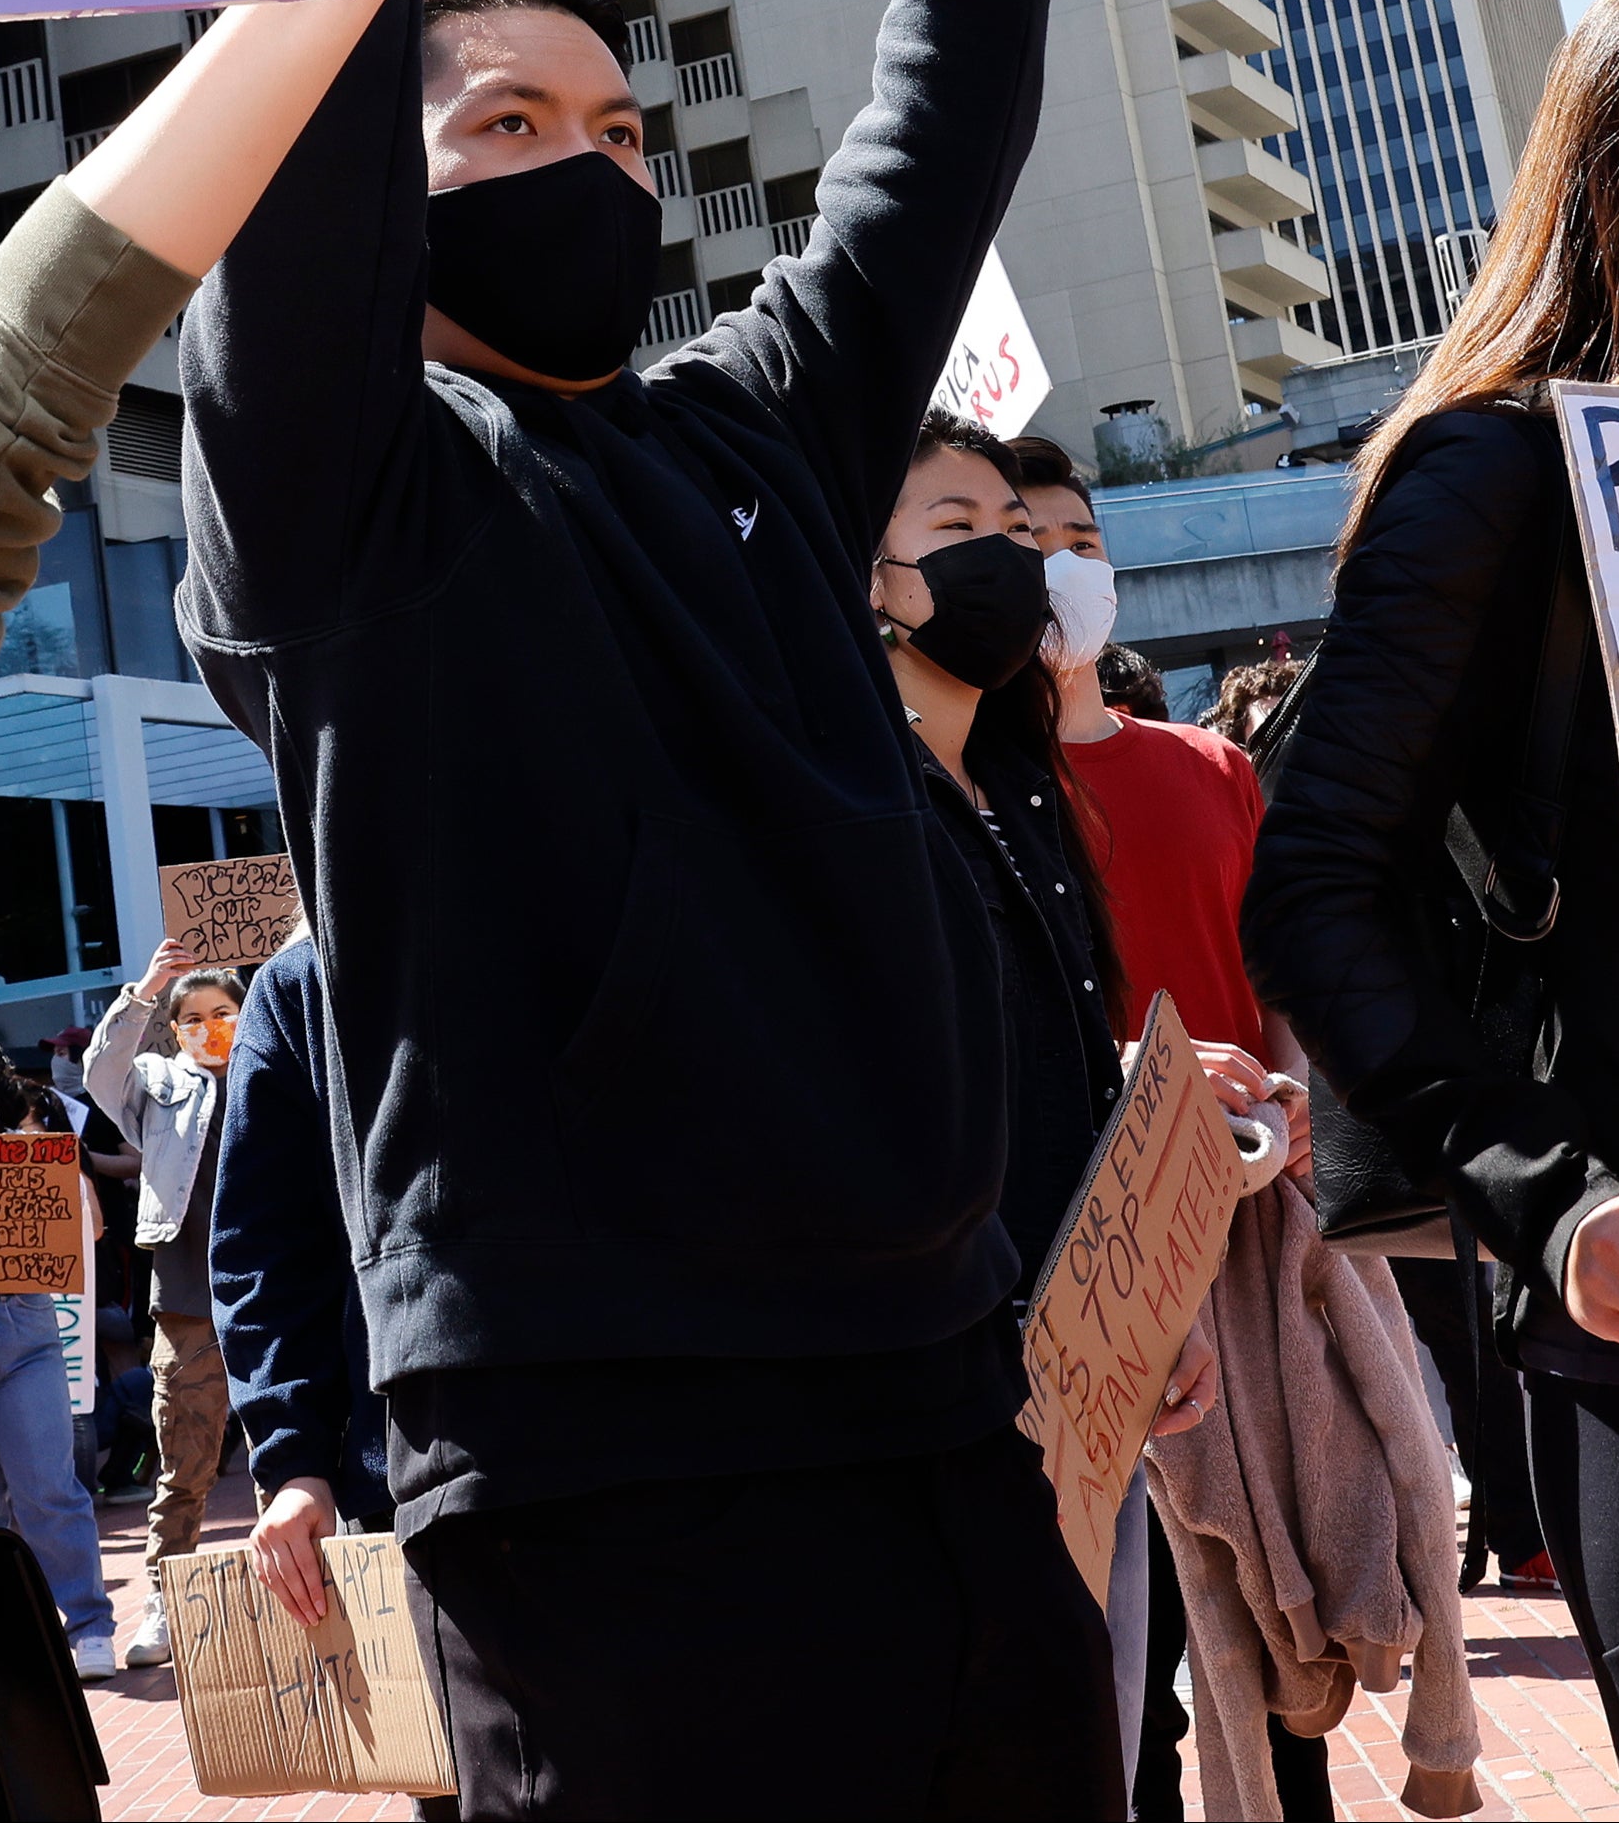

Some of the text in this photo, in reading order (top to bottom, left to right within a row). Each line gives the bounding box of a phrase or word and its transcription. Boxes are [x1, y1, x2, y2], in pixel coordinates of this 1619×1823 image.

[938, 342, 980, 409] RICA
[970, 332, 1021, 429] RUS
[172, 854, 298, 918] protect
[211, 896, 261, 925] our
[31, 1134, 77, 1165] not
[1069, 1194, 1112, 1287] OUR
[1110, 1025, 1172, 1193] ELDERS
[1078, 1324, 1152, 1553] ASIAN
[183, 1558, 274, 1640] STO
[266, 1648, 362, 1731] HATE
